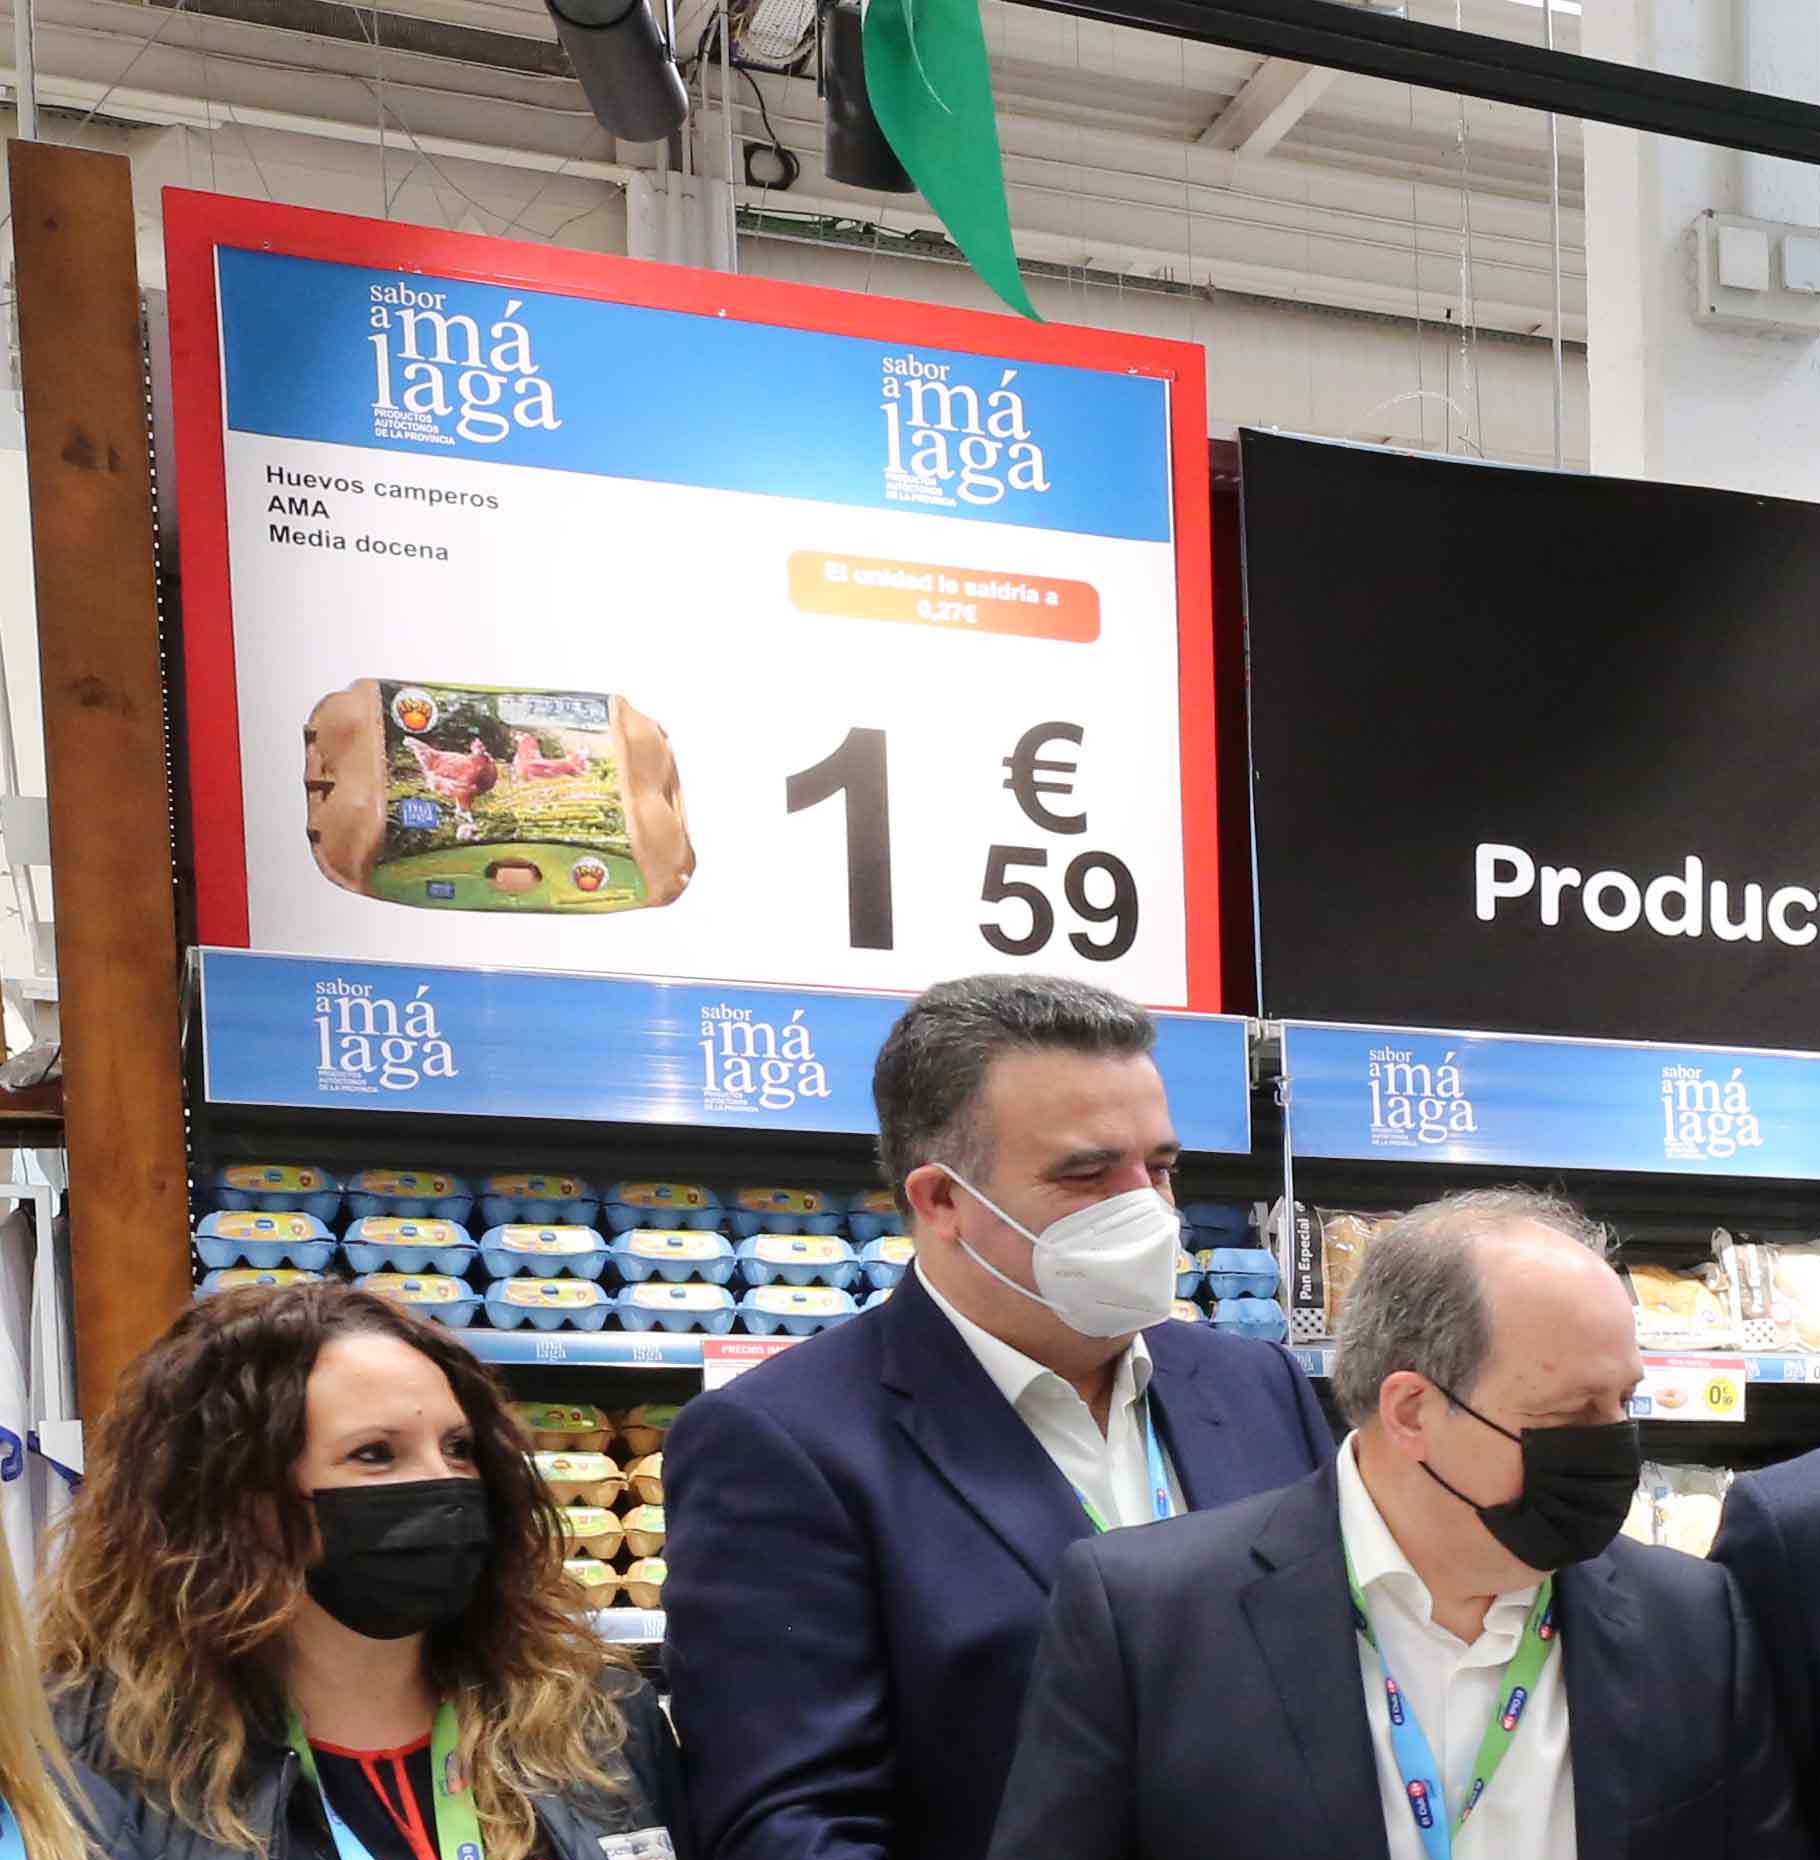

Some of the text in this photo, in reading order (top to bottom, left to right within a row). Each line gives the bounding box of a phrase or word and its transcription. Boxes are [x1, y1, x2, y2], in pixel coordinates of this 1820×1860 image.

[370, 282, 447, 310] sabor
[370, 300, 539, 375] a má
[368, 333, 562, 443] laga
[882, 354, 949, 381] sabor
[374, 408, 432, 424] PRODUCTOS
[883, 370, 1031, 440] a má
[375, 428, 456, 446] DE LA PROVINCIA
[880, 403, 1050, 504] laga
[266, 465, 499, 509] Huevos camperos
[267, 495, 330, 519] AMA
[269, 524, 448, 560] Media docena
[1044, 590, 1060, 606] a
[786, 720, 1089, 951] 1 €
[976, 845, 1141, 962] 59
[315, 979, 372, 997] sabor
[316, 986, 441, 1039] a má
[701, 1004, 753, 1021] sabor
[702, 1009, 814, 1061] a má
[313, 1015, 459, 1090] laga
[700, 1039, 832, 1111] laga
[1369, 1047, 1412, 1063] sabor
[1385, 1051, 1464, 1098] má
[1662, 1064, 1702, 1080] sabor
[1368, 1079, 1478, 1144] laga
[1676, 1068, 1751, 1114] má
[1661, 1095, 1763, 1158] laga
[1297, 1218, 1313, 1300] Pan Especial
[1709, 1385, 1722, 1405] 0
